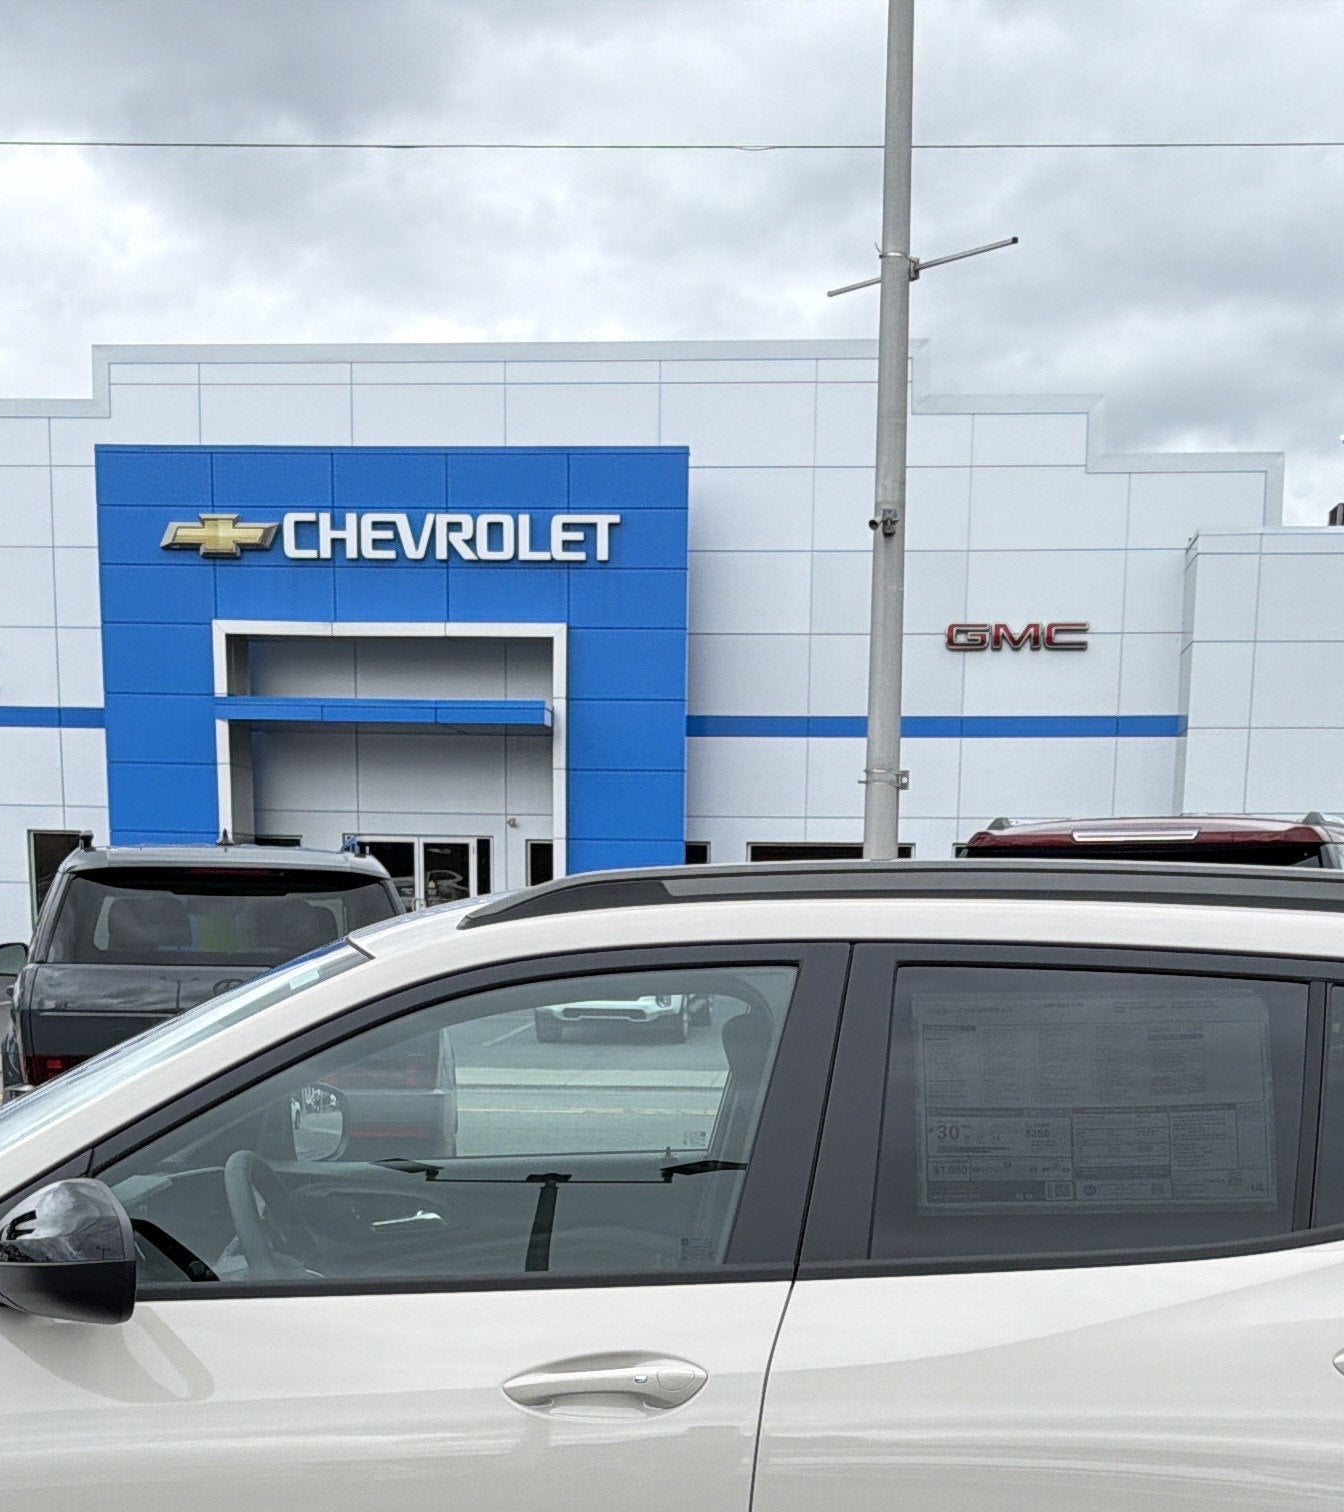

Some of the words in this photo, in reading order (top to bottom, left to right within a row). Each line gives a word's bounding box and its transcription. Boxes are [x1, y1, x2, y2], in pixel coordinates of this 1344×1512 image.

[282, 512, 621, 562] CHEVROLET
[946, 623, 1089, 651] GMC
[937, 1124, 960, 1140] 30
